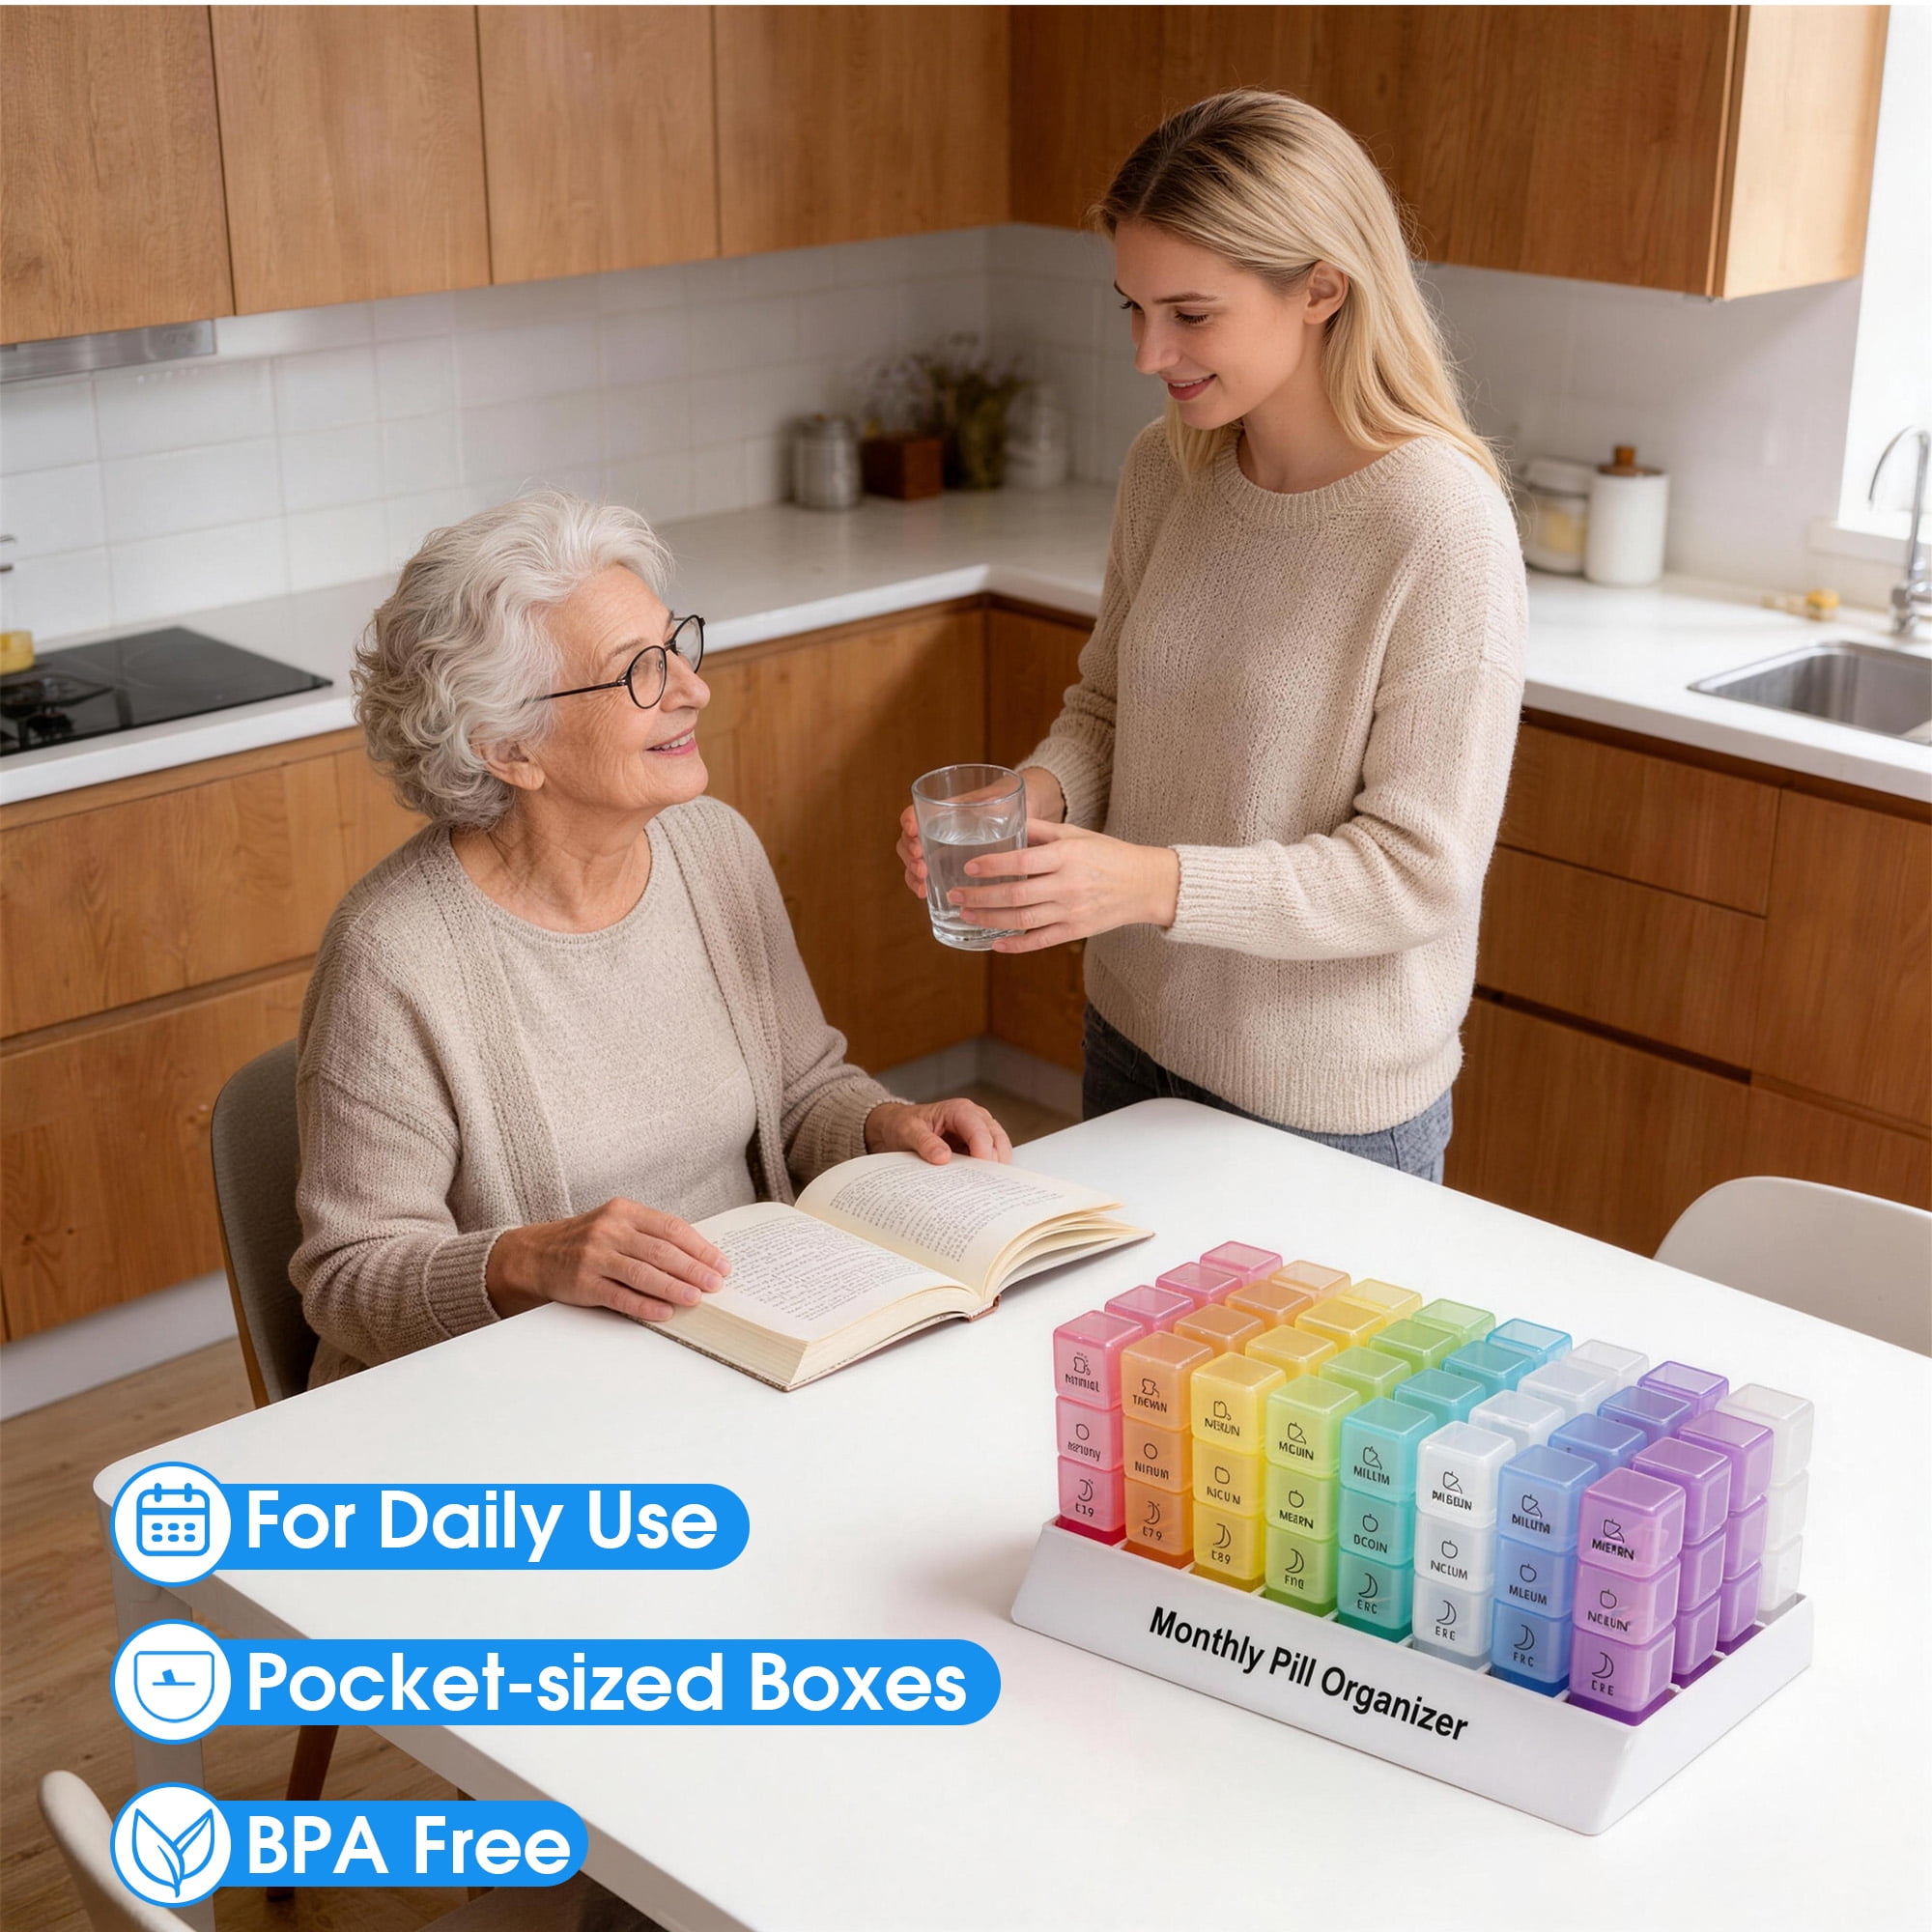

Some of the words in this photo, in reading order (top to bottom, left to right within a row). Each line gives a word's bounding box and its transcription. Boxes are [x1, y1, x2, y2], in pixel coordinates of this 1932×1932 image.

[1149, 1606, 1264, 1674] Monthly
[1269, 1647, 1317, 1687] Pill
[1321, 1667, 1468, 1741] Organizer
